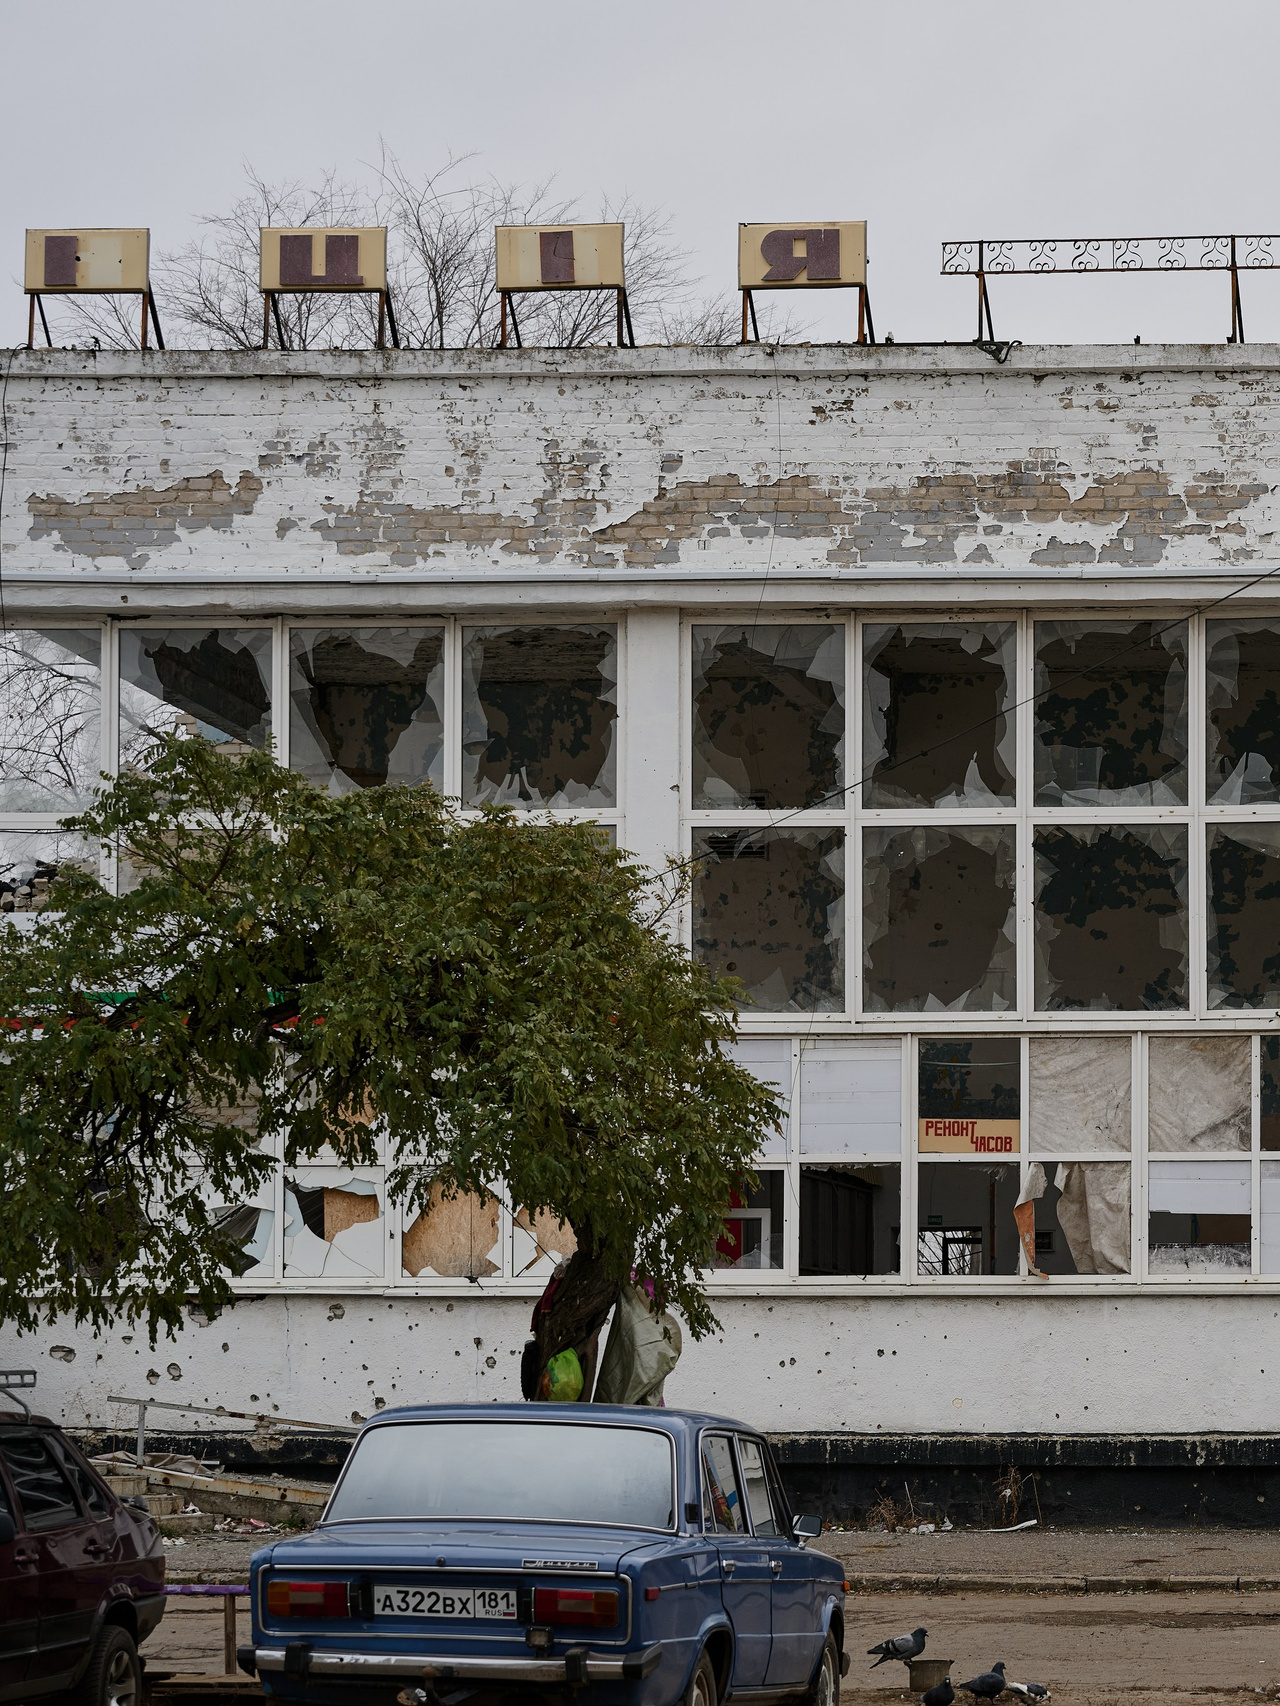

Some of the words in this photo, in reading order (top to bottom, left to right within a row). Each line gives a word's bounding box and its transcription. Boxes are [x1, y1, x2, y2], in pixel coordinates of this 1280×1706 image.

[970, 1136, 1013, 1152] ЧАСОВ
[381, 1589, 472, 1615] А322ВХ
[476, 1591, 511, 1610] 181
[484, 1609, 503, 1617] RUS
